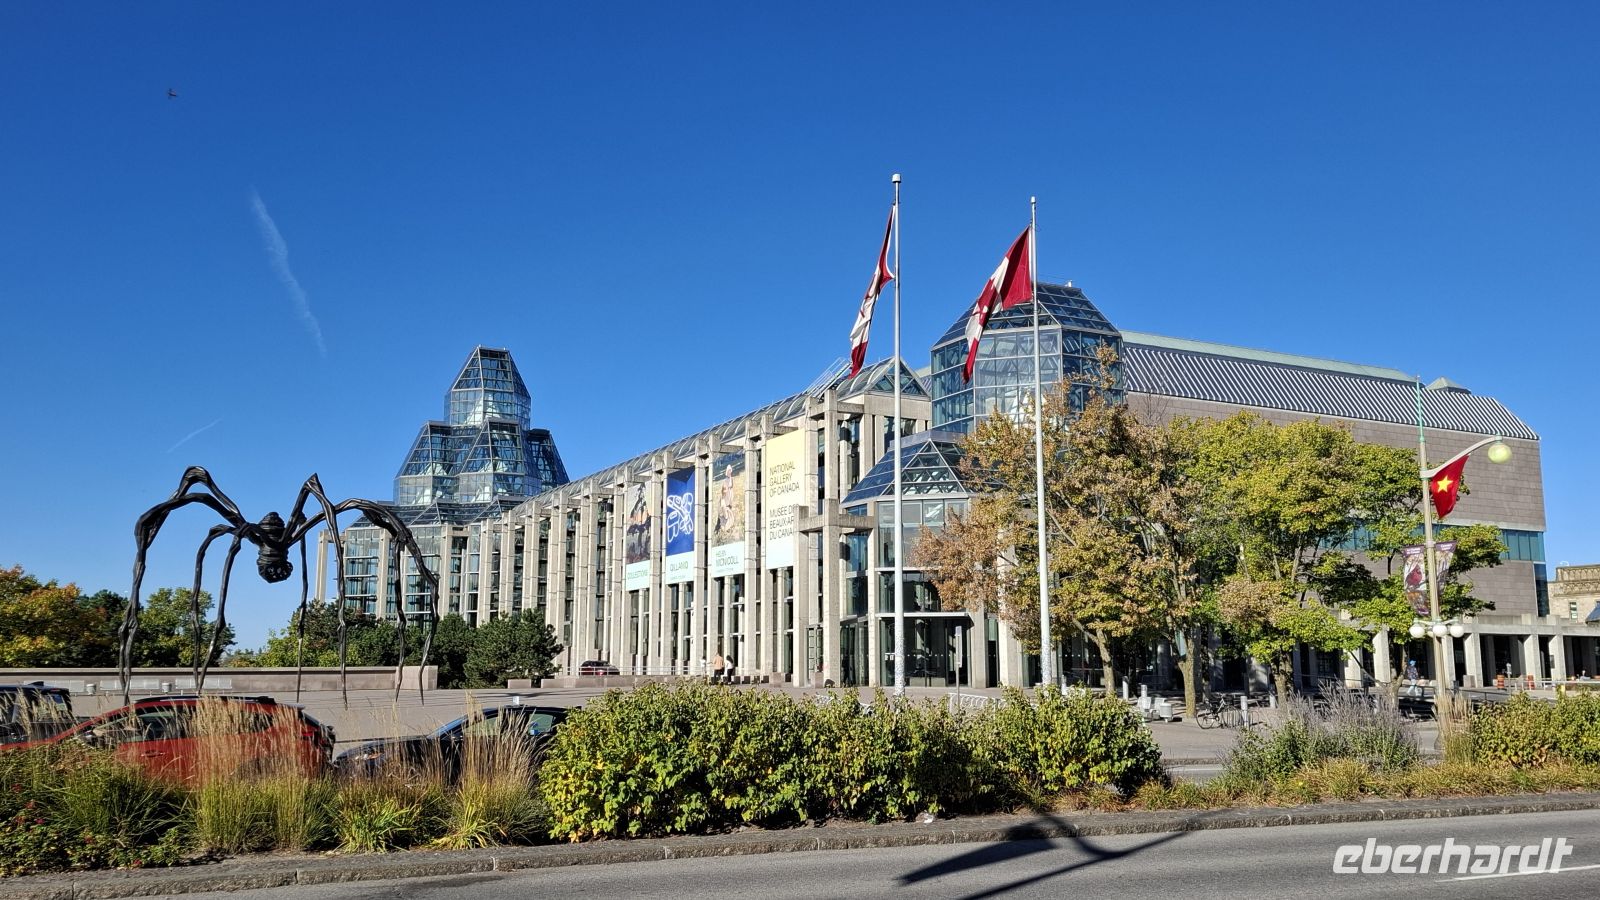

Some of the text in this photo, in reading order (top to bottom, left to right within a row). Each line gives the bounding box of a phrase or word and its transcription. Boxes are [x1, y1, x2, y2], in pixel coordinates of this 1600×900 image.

[769, 461, 795, 476] NATIONAL
[769, 473, 792, 487] GALLERY
[769, 482, 800, 498] OF CANADA
[769, 531, 777, 541] DU
